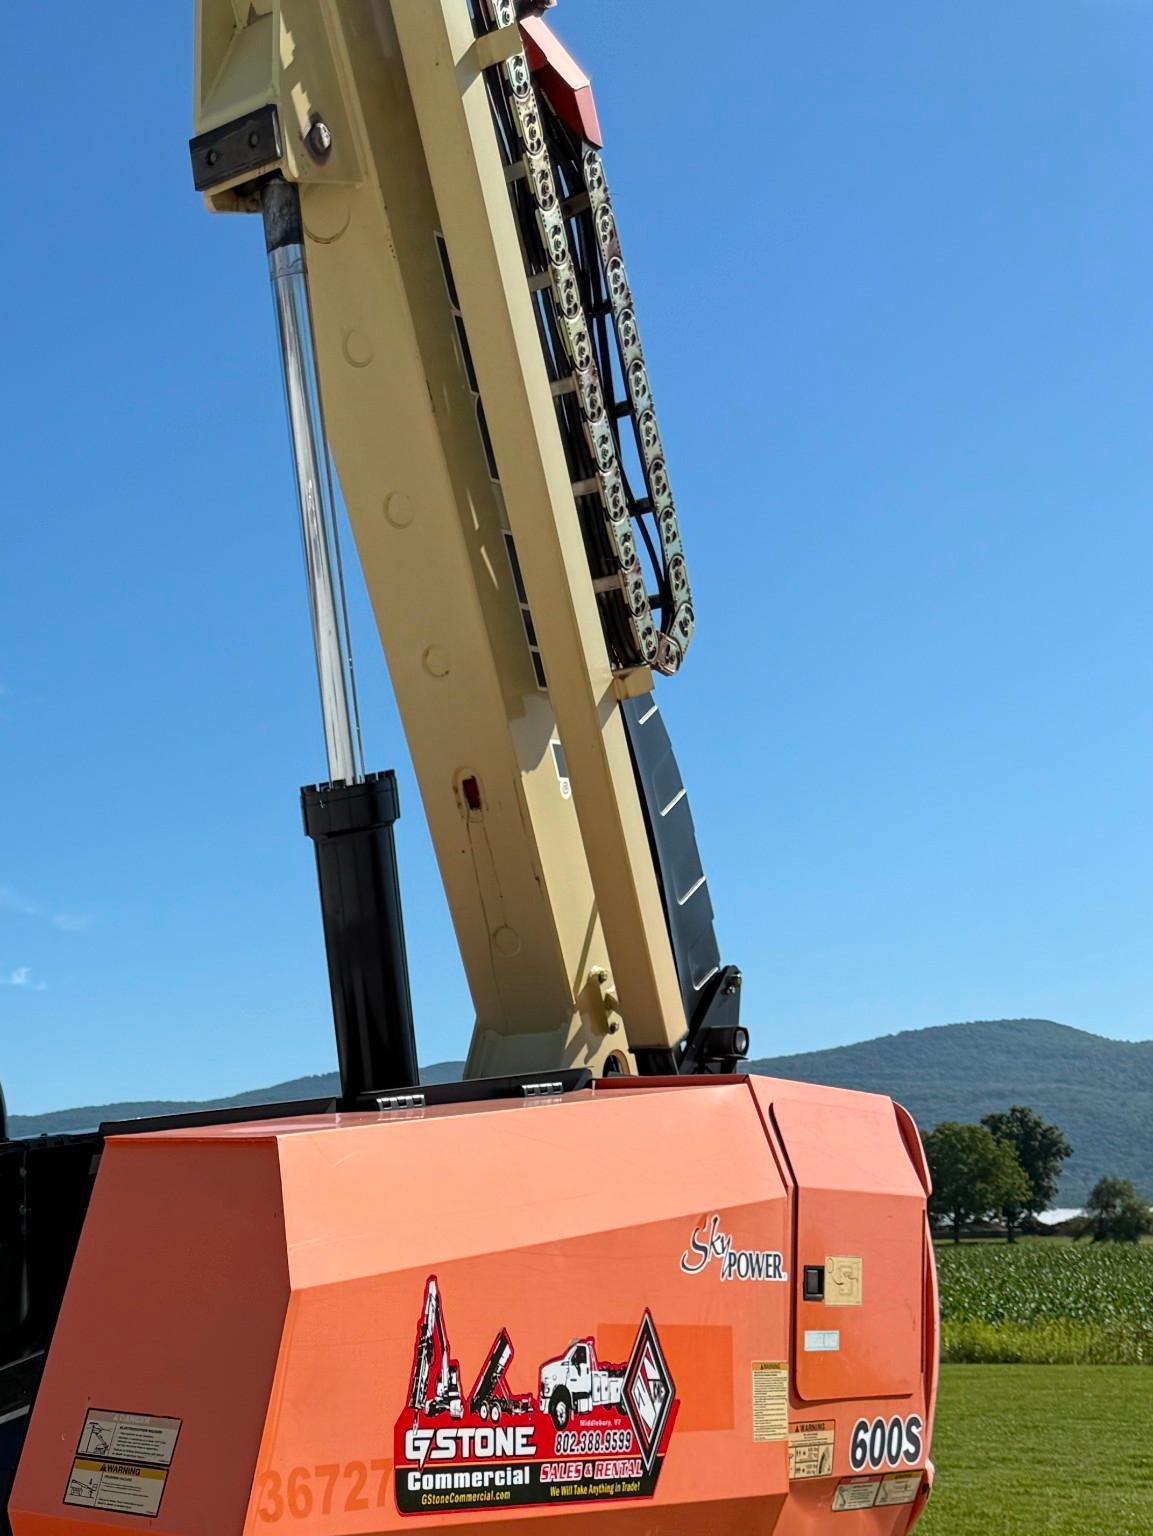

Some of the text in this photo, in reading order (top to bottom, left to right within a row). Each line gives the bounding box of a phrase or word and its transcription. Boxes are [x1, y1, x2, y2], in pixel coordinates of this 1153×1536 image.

[681, 1215, 783, 1279] Sky POWER
[555, 1430, 632, 1454] 802.388.9599
[850, 1415, 922, 1469] 600S
[107, 1464, 141, 1477] WARNING
[407, 1466, 531, 1491] Commercial
[540, 1460, 643, 1482] SALES & RENTAL
[257, 1457, 393, 1523] 36727
[421, 1490, 511, 1505] GStoneCommercial.com
[550, 1486, 560, 1497] We
[561, 1485, 573, 1496] Will
[574, 1484, 587, 1495] Take
[589, 1482, 614, 1496] Anything
[622, 1481, 641, 1493] Trade!
